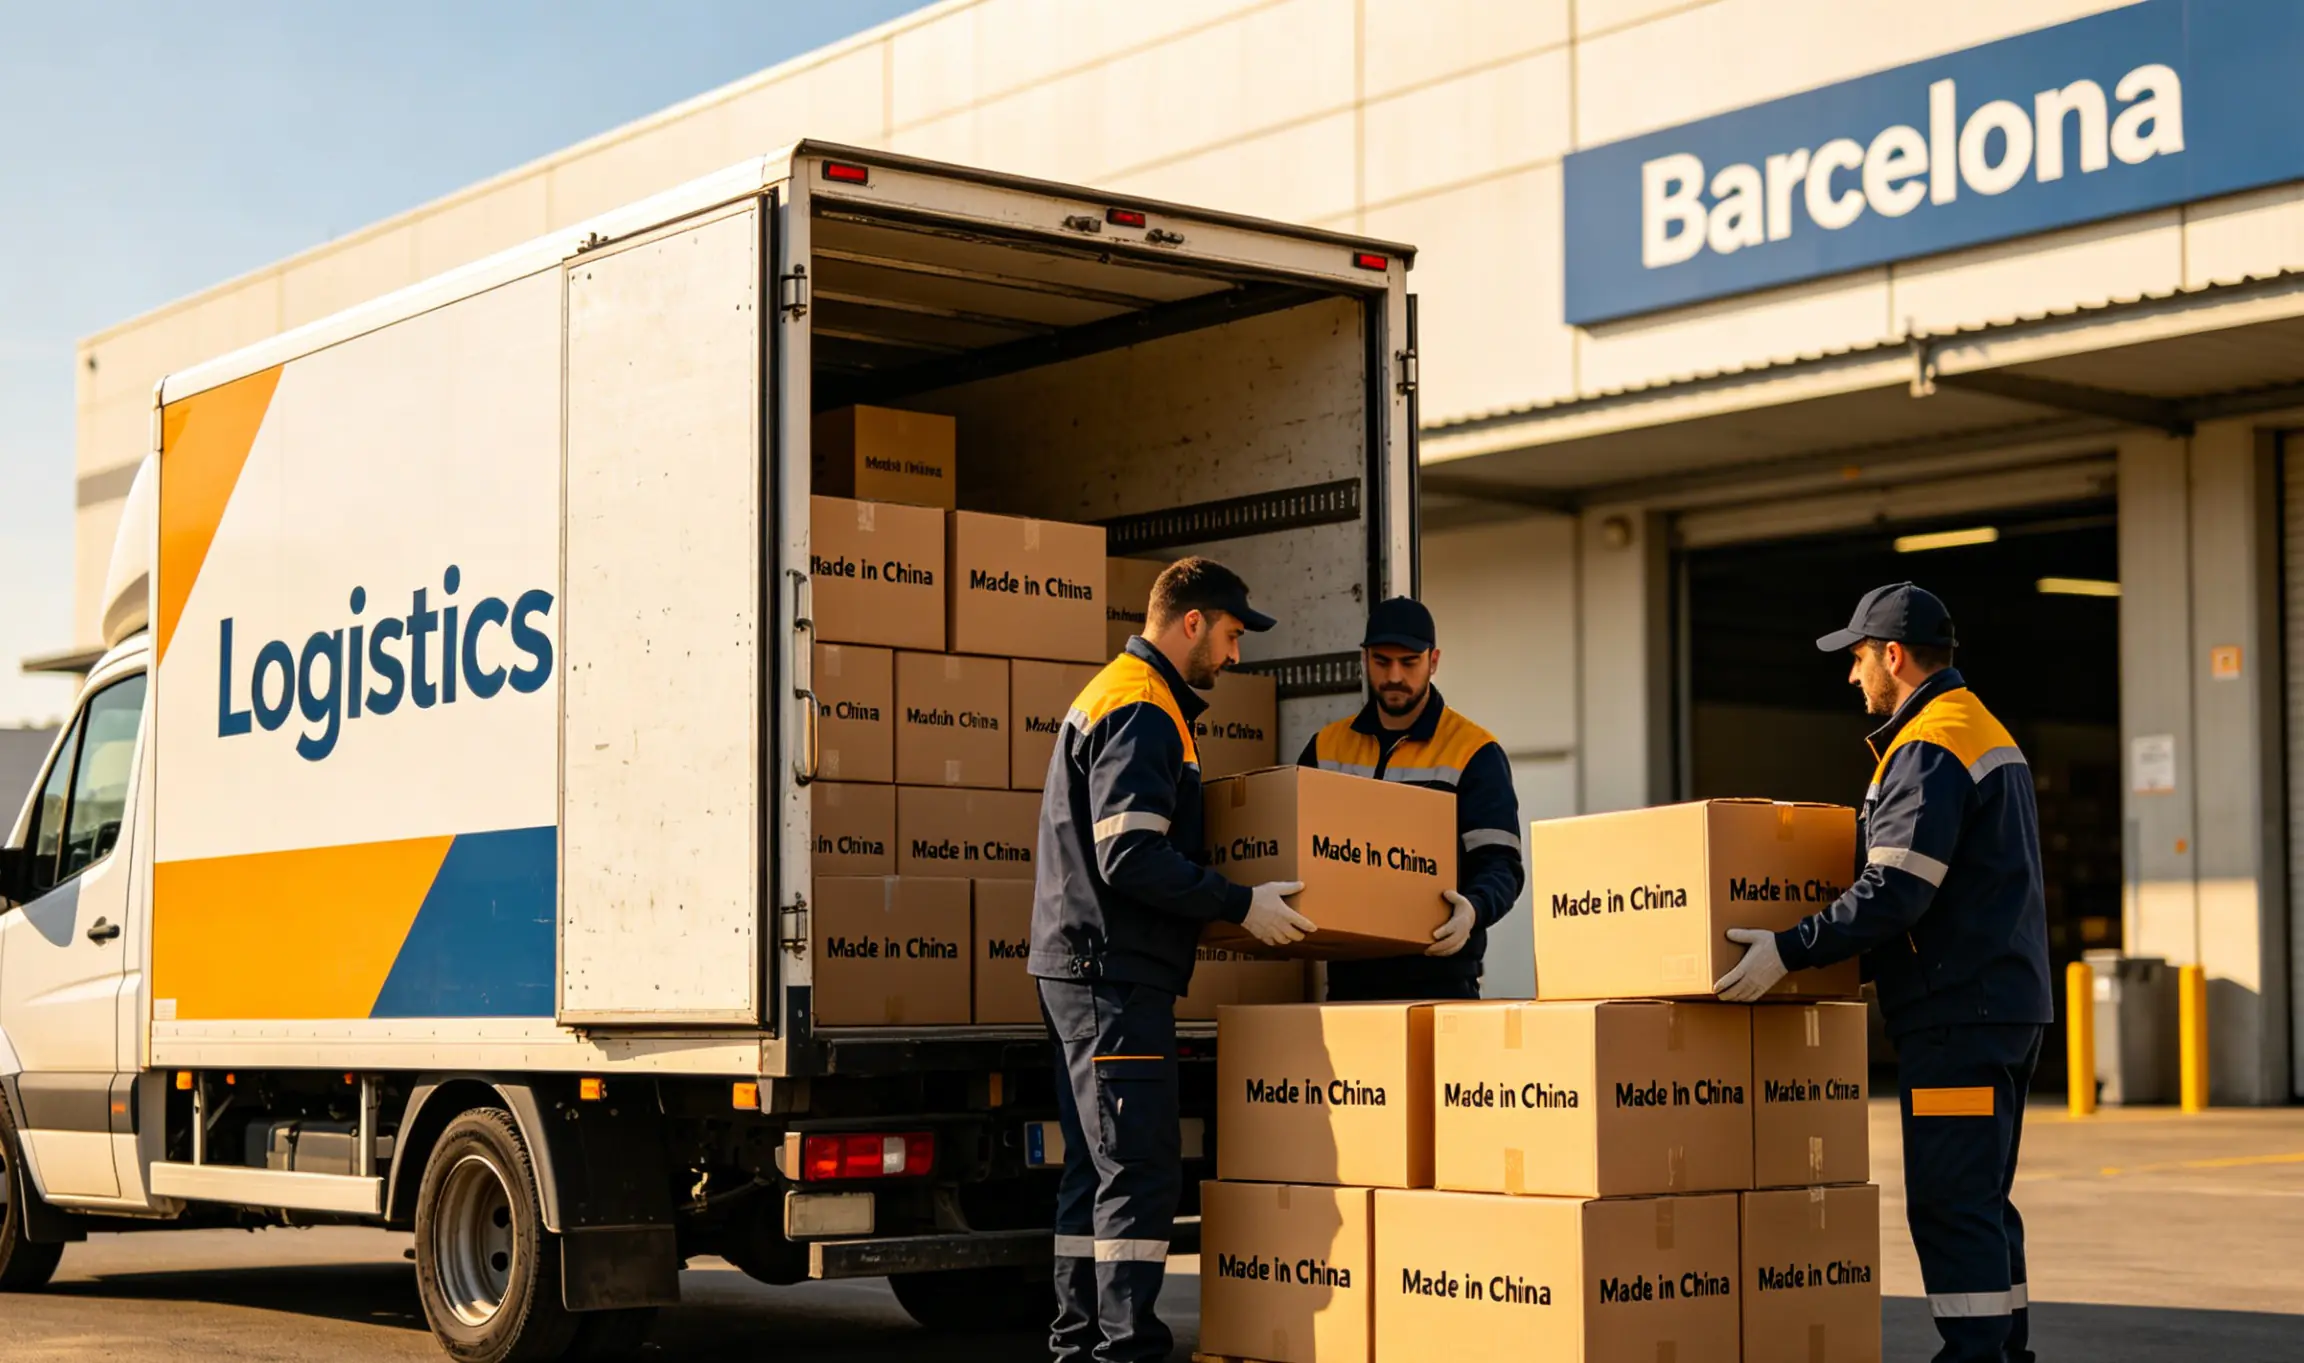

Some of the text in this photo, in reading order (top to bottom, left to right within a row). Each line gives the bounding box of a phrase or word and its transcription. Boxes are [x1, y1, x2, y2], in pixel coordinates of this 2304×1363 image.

[1641, 63, 2185, 269] Barcelona
[861, 559, 878, 580] in
[883, 561, 933, 585] China
[970, 569, 1093, 600] Made in China
[218, 564, 555, 762] Logistics
[838, 836, 884, 855] China
[912, 839, 1031, 862] Made in China
[1231, 836, 1278, 861] China
[1313, 835, 1437, 876] Made in China
[1552, 884, 1687, 918] Made in China
[1730, 877, 1780, 902] Made
[1785, 879, 1801, 902] in
[827, 936, 958, 959] Made in China
[1246, 1078, 1386, 1106] Made in China
[1444, 1081, 1578, 1108] Made in China
[1616, 1079, 1743, 1108] Made in China
[1764, 1078, 1860, 1103] Made in China
[1218, 1253, 1351, 1288] Made in China
[1758, 1260, 1871, 1292] Made in China
[1402, 1268, 1551, 1306] Made in China
[1600, 1271, 1730, 1304] Made in China
